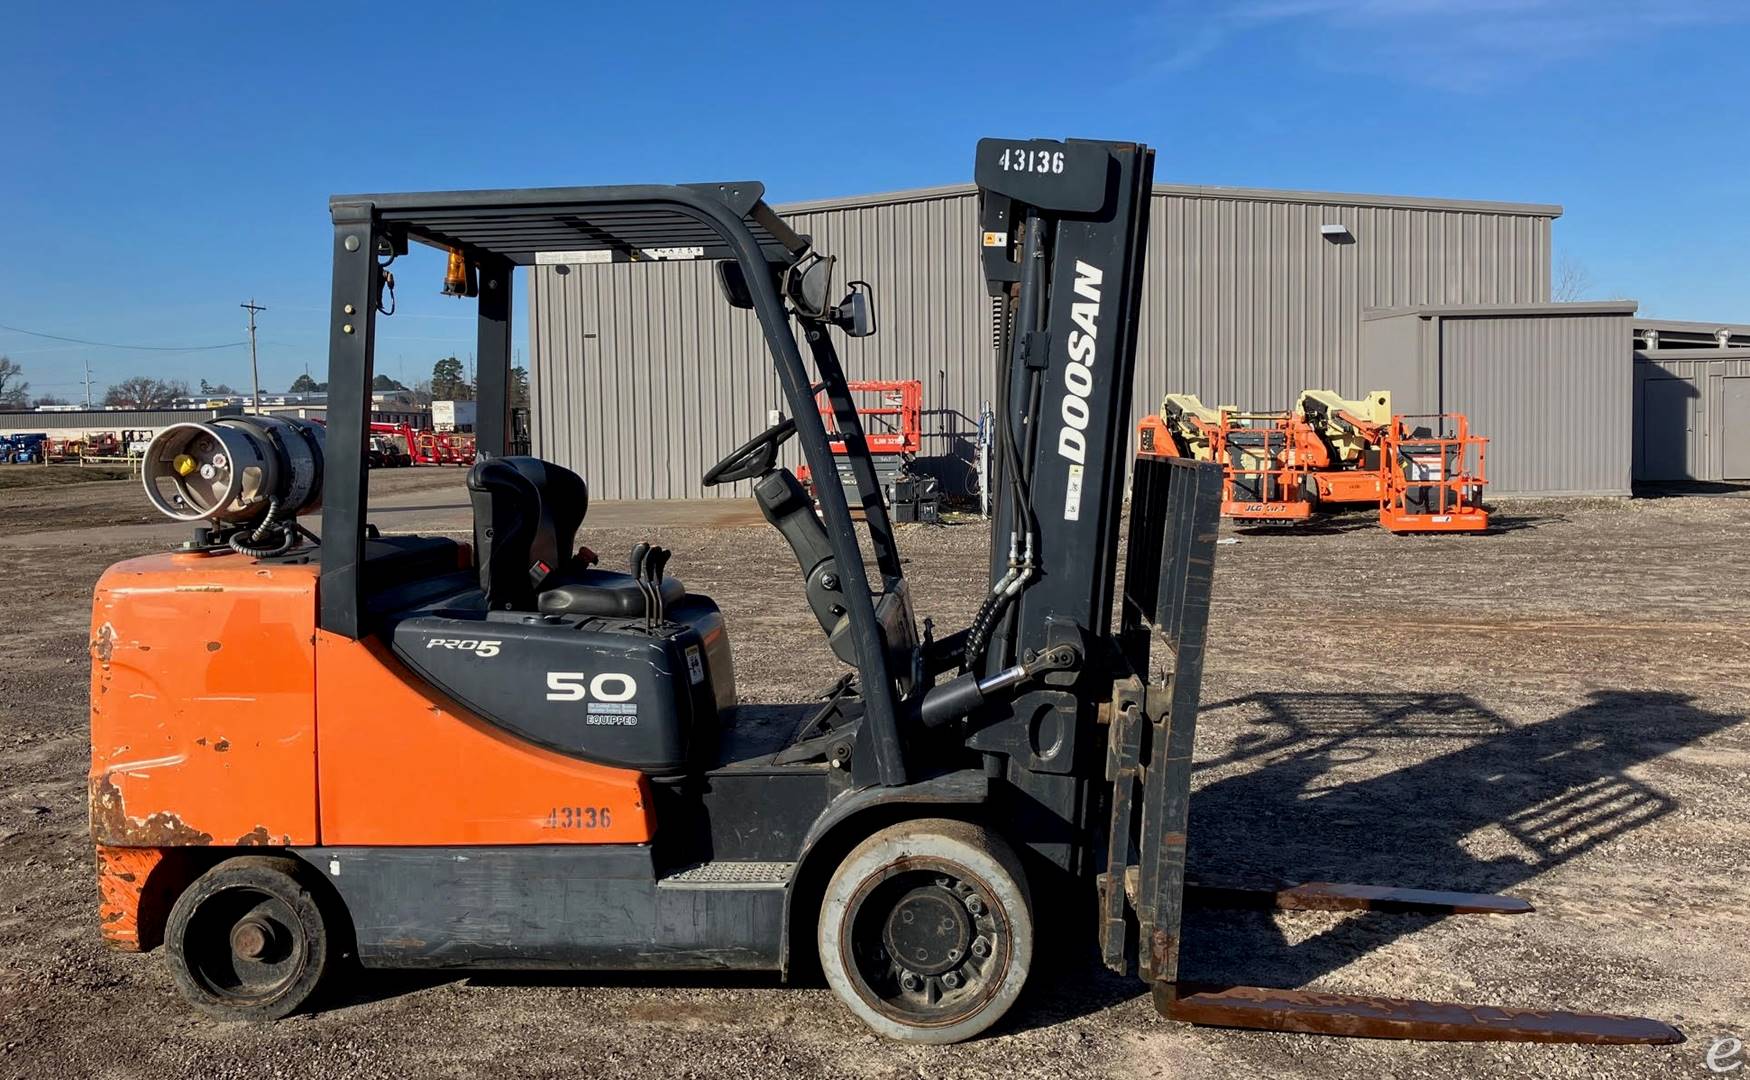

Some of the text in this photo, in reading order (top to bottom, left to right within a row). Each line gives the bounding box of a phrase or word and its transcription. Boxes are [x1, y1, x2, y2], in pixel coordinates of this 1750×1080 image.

[998, 148, 1065, 174] 43136
[1058, 260, 1104, 465] DOOSAN
[1245, 504, 1263, 512] JLG
[426, 638, 502, 657] PRO5
[546, 671, 637, 702] 50
[586, 715, 638, 726] EQUIPPED
[543, 806, 612, 829] 43136
